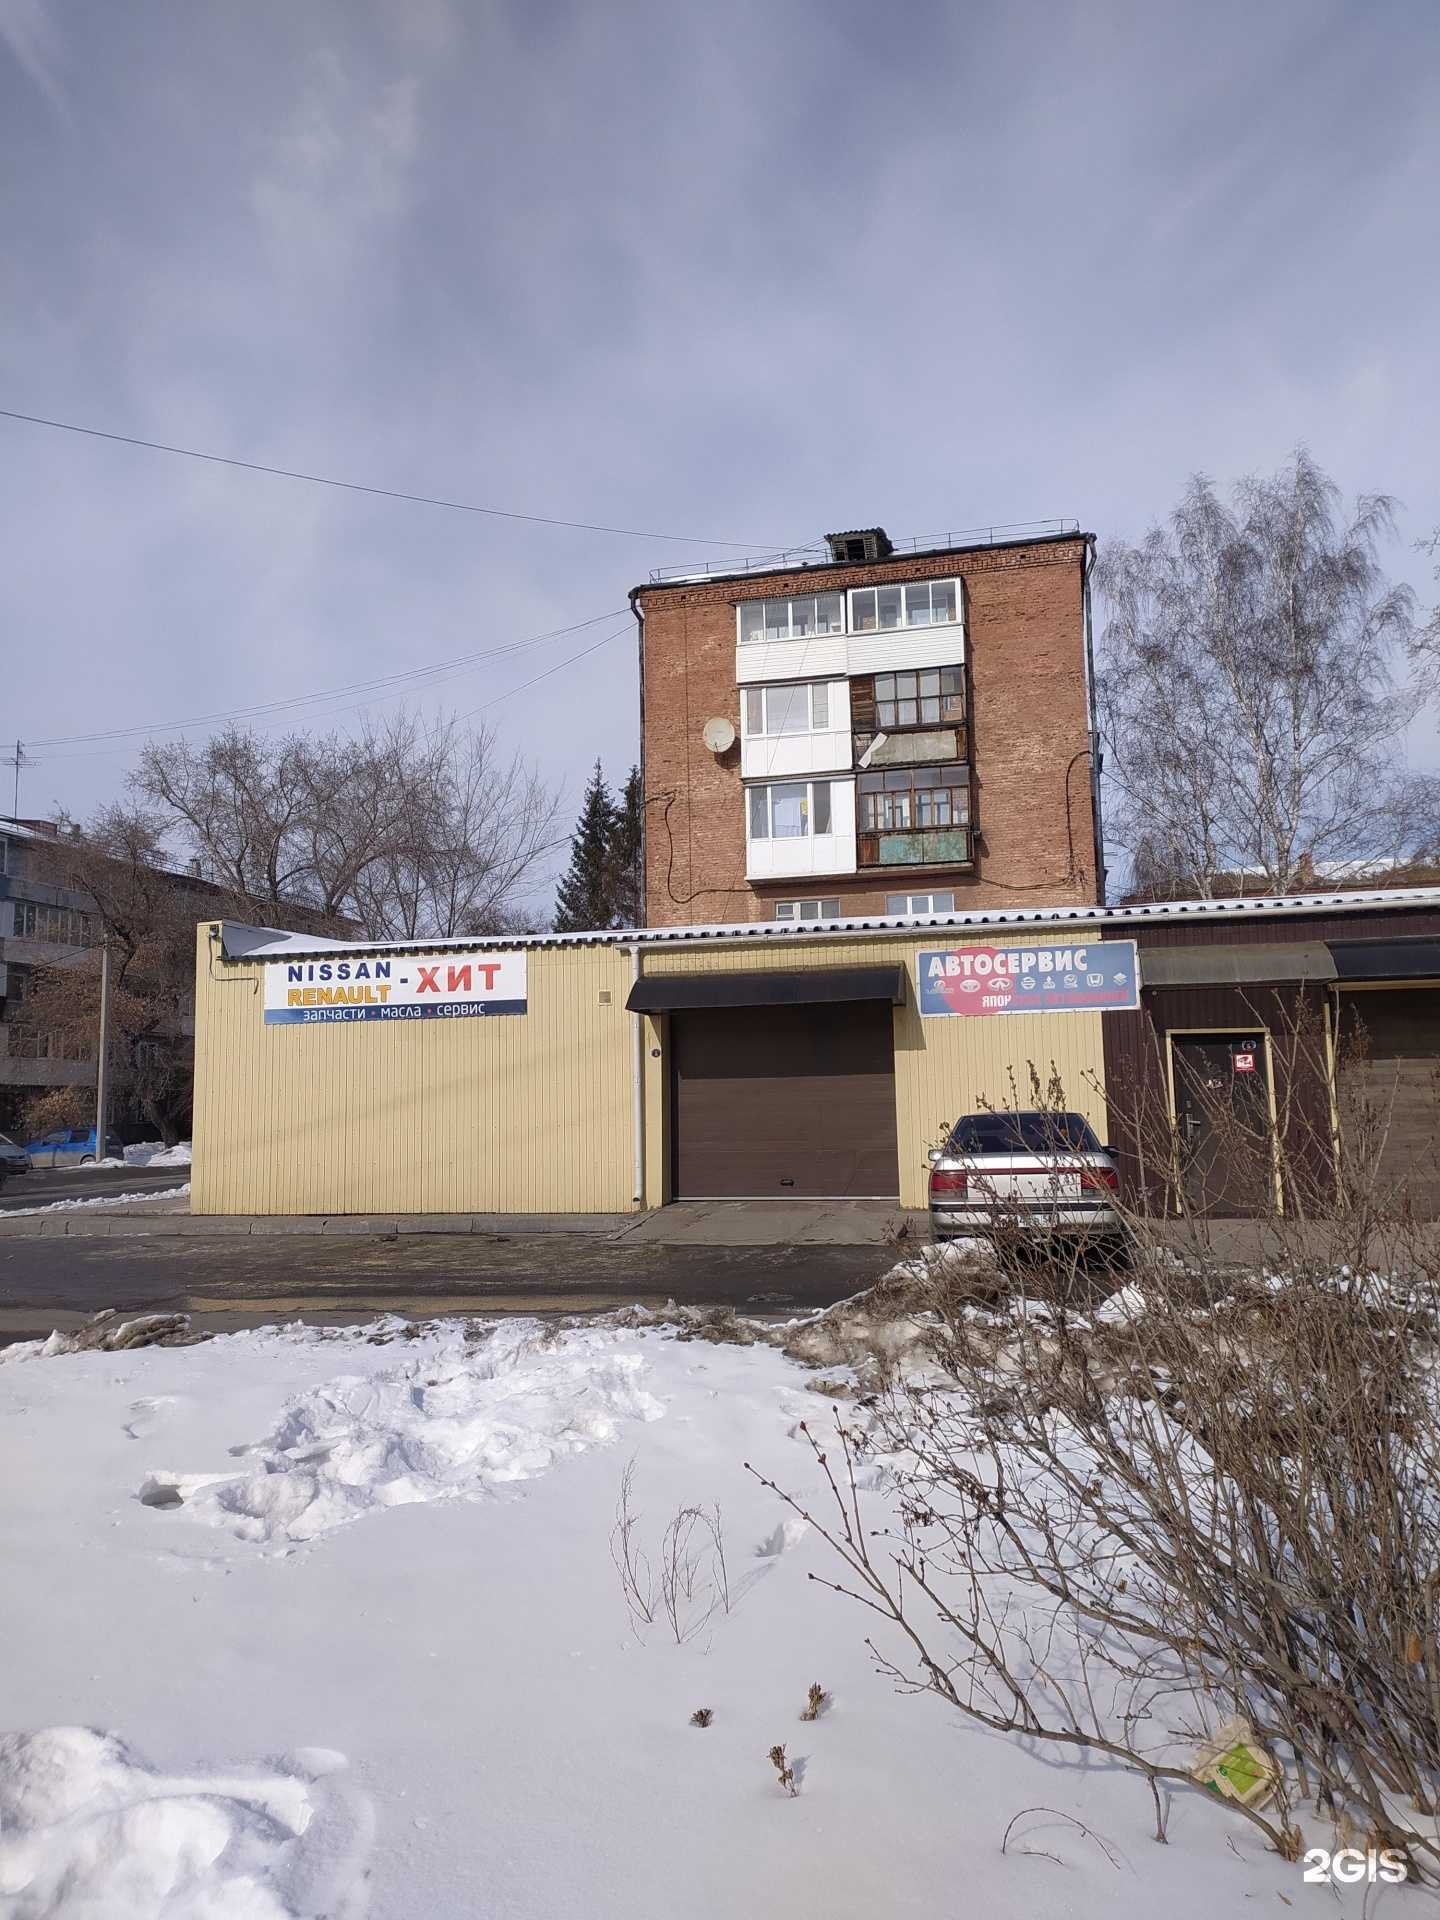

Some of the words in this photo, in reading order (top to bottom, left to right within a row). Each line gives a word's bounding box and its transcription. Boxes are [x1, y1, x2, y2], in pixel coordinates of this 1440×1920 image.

[288, 961, 391, 982] NISSAN
[928, 949, 1088, 977] АВТОСЕРВИС
[287, 985, 391, 1006] RENAULT
[303, 1008, 366, 1021] запчасти
[381, 1006, 421, 1017] масла
[437, 1003, 485, 1017] сервис
